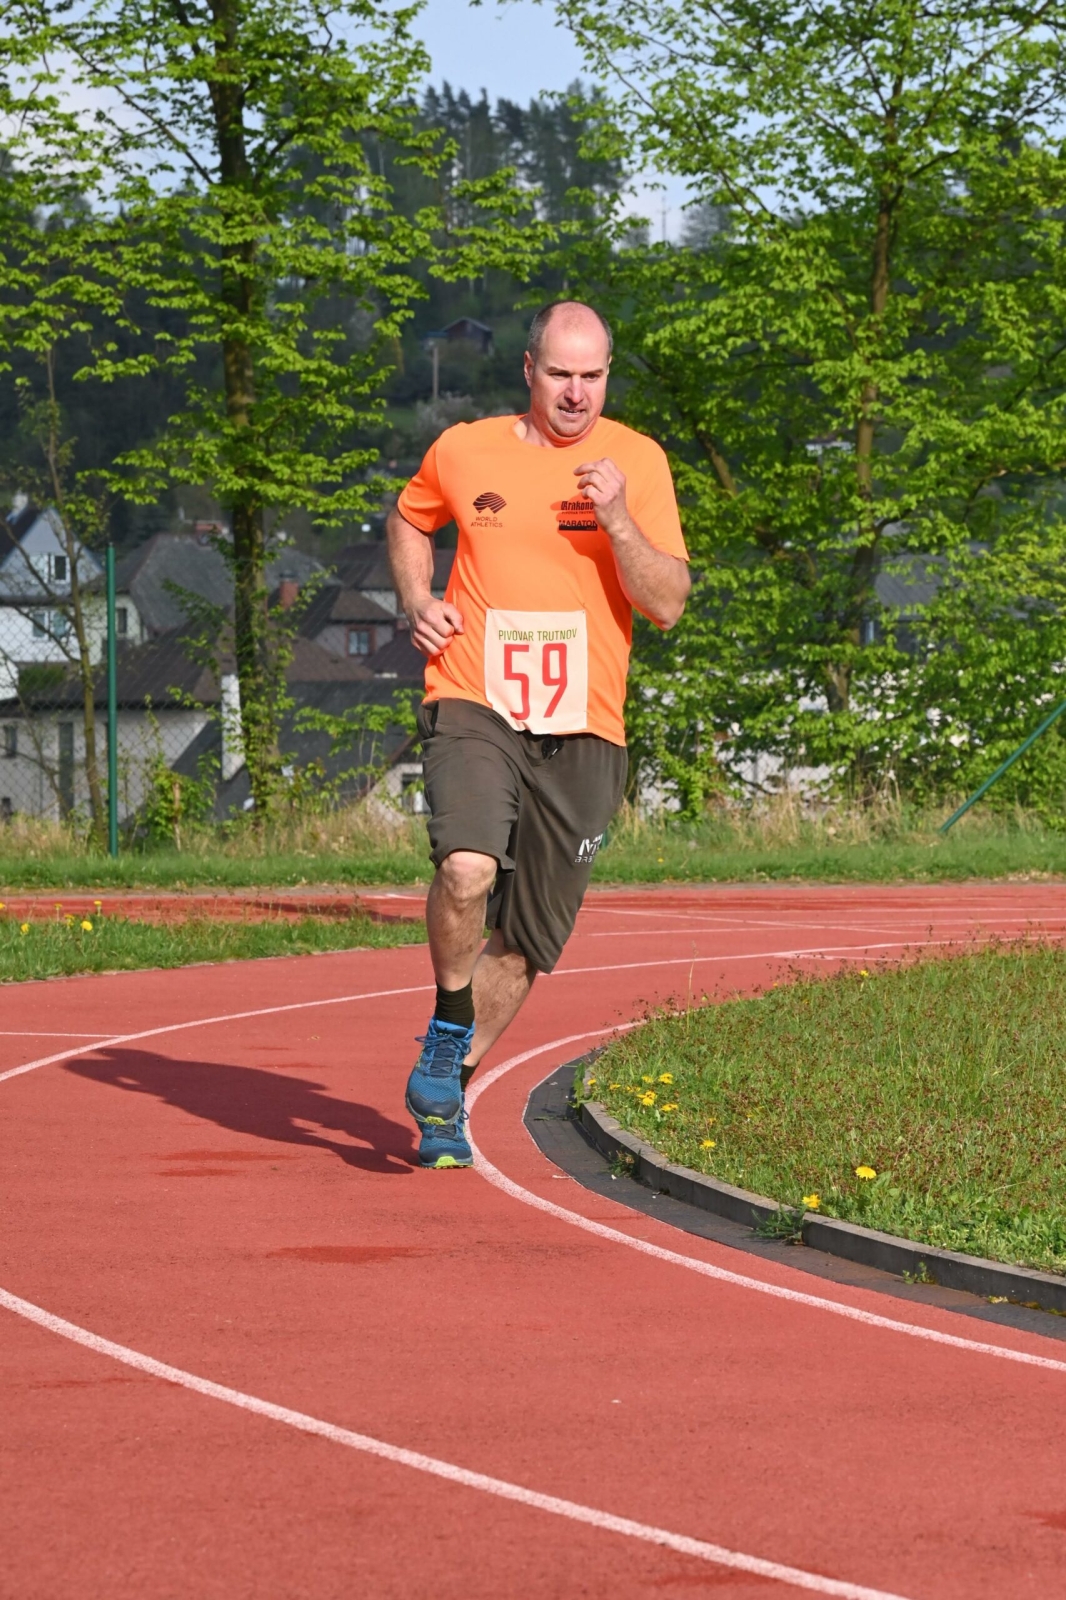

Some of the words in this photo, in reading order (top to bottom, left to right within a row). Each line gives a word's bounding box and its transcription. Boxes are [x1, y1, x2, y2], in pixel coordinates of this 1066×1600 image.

[561, 501, 594, 511] Krakono
[498, 629, 534, 642] PIVOVAR
[536, 628, 578, 642] TRUTNOV
[503, 642, 568, 721] 59
